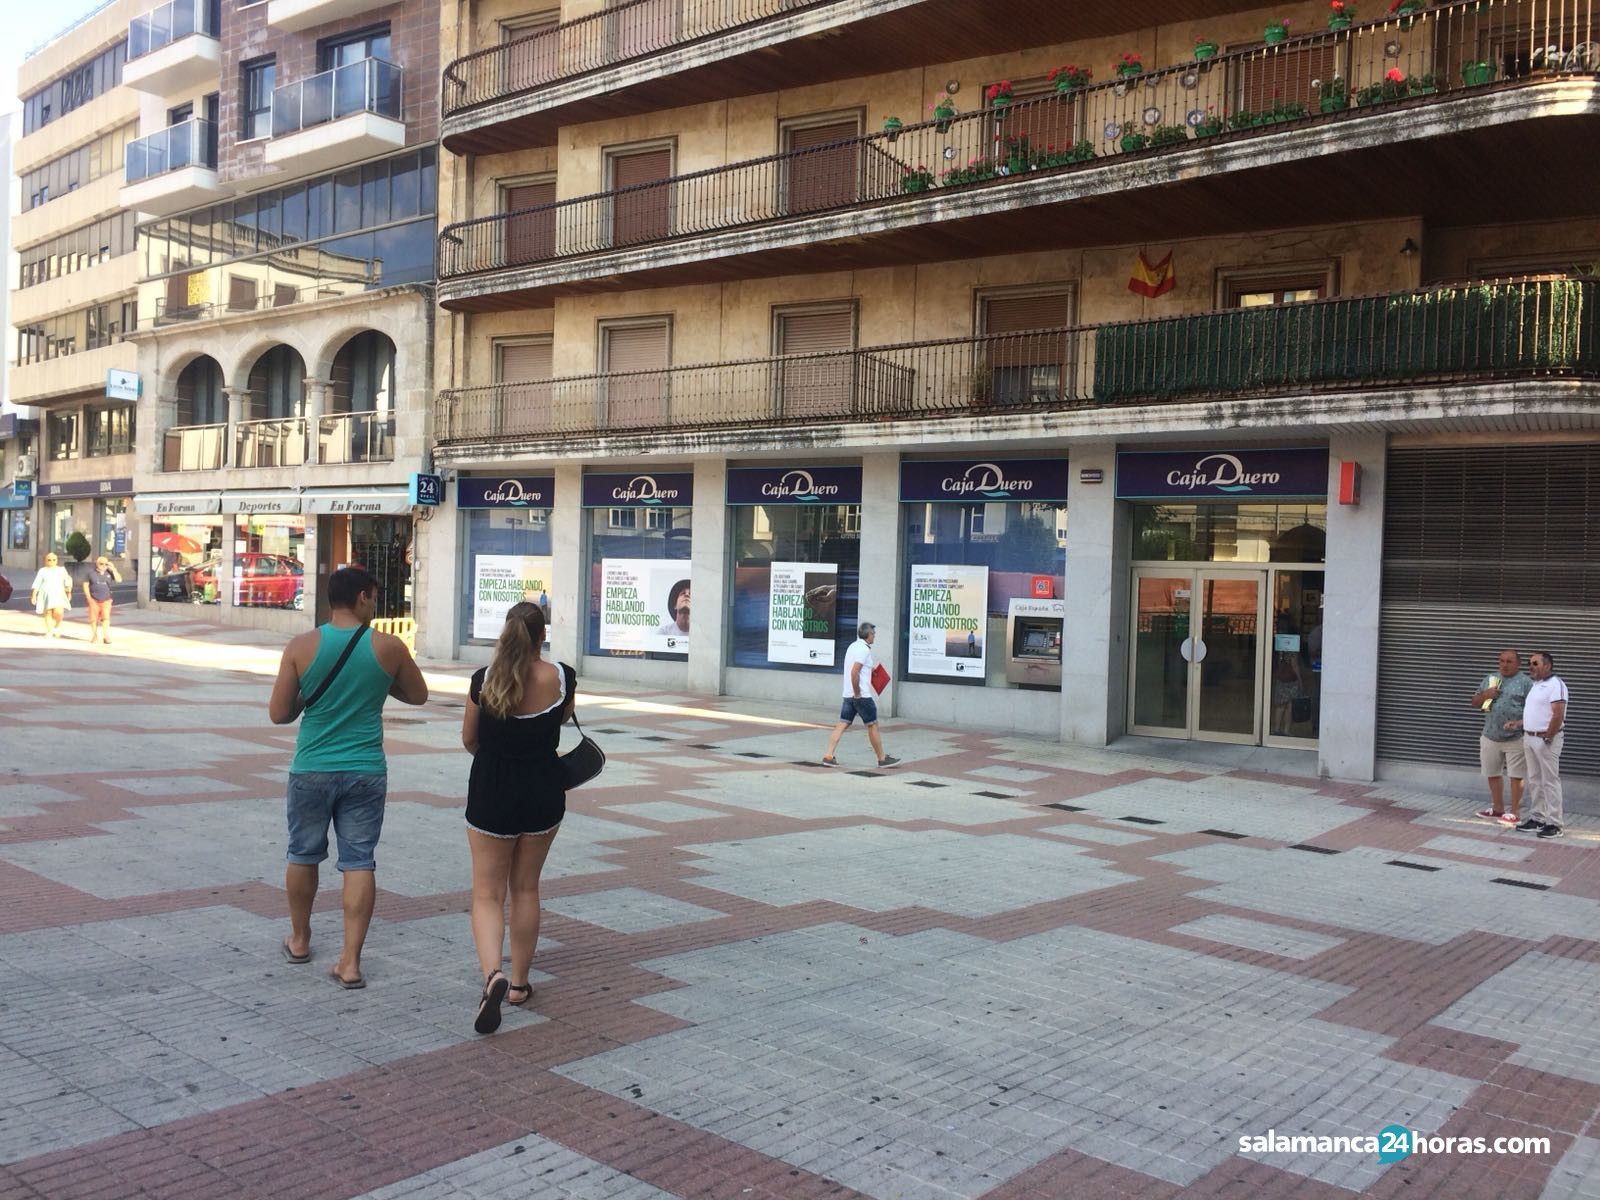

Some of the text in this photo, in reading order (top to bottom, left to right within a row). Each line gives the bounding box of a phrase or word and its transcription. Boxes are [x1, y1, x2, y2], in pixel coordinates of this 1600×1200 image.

[1166, 453, 1281, 491] Caja Duero
[761, 470, 839, 500] Caja Duero
[941, 463, 1034, 496] Caja Duero
[419, 480, 434, 494] 24
[484, 479, 542, 504] Caja Duero
[612, 475, 679, 502] Caja Duero
[156, 502, 196, 513] En Forma
[238, 501, 282, 513] Deportes
[330, 499, 382, 512] En Forma
[479, 578, 543, 592] EMPIEZA HABLANDO
[479, 590, 527, 602] CON NOSOTROS
[606, 587, 638, 600] EMPIEZA
[772, 594, 805, 606] EMPIEZA
[914, 588, 952, 602] EMPIEZA
[605, 600, 645, 613] HABLANDO
[772, 606, 813, 619] HABLANDO
[913, 602, 961, 616] HABLANDO
[605, 613, 660, 627] CON NOSOTROS
[771, 619, 829, 633] CON NOSOTROS
[913, 616, 978, 631] CON NOSOTROS
